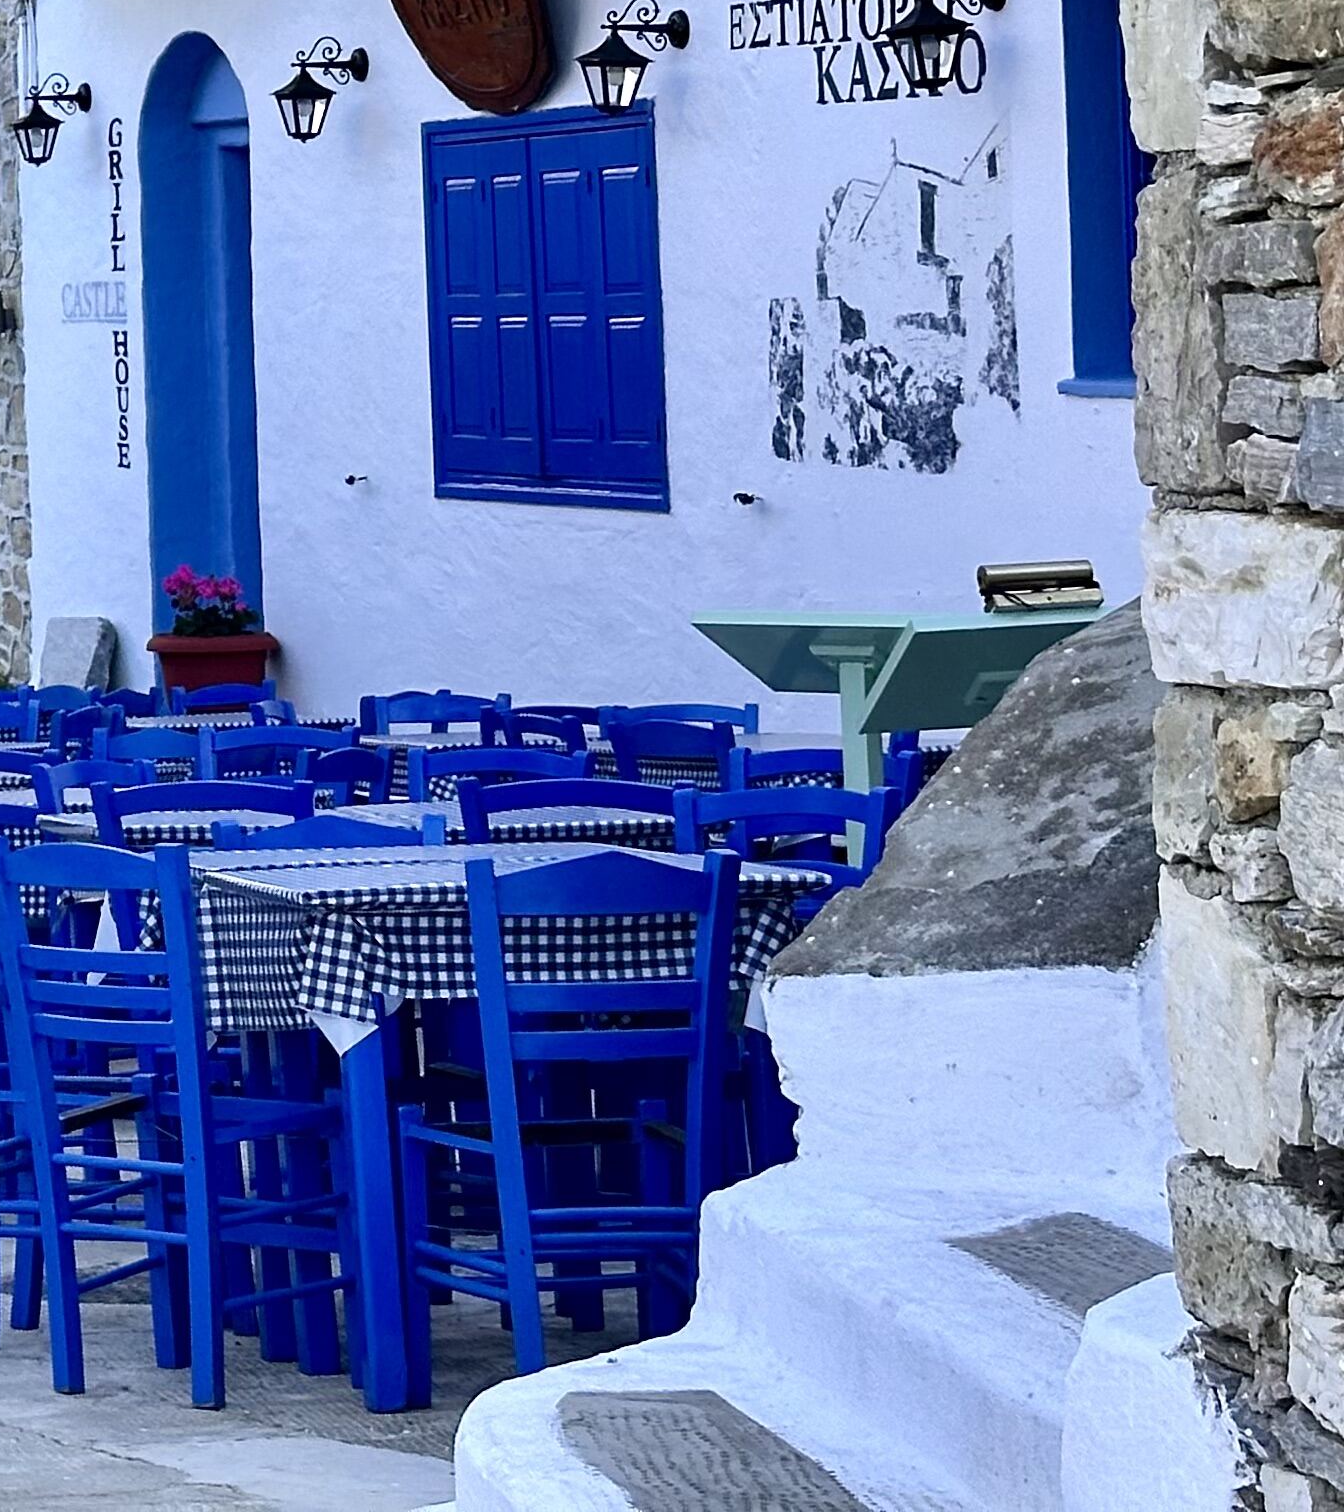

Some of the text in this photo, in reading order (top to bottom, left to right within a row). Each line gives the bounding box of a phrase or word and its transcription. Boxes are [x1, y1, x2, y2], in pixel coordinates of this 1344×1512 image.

[61, 281, 128, 318] CASTLE
[108, 117, 131, 469] GRILL HOUSE
